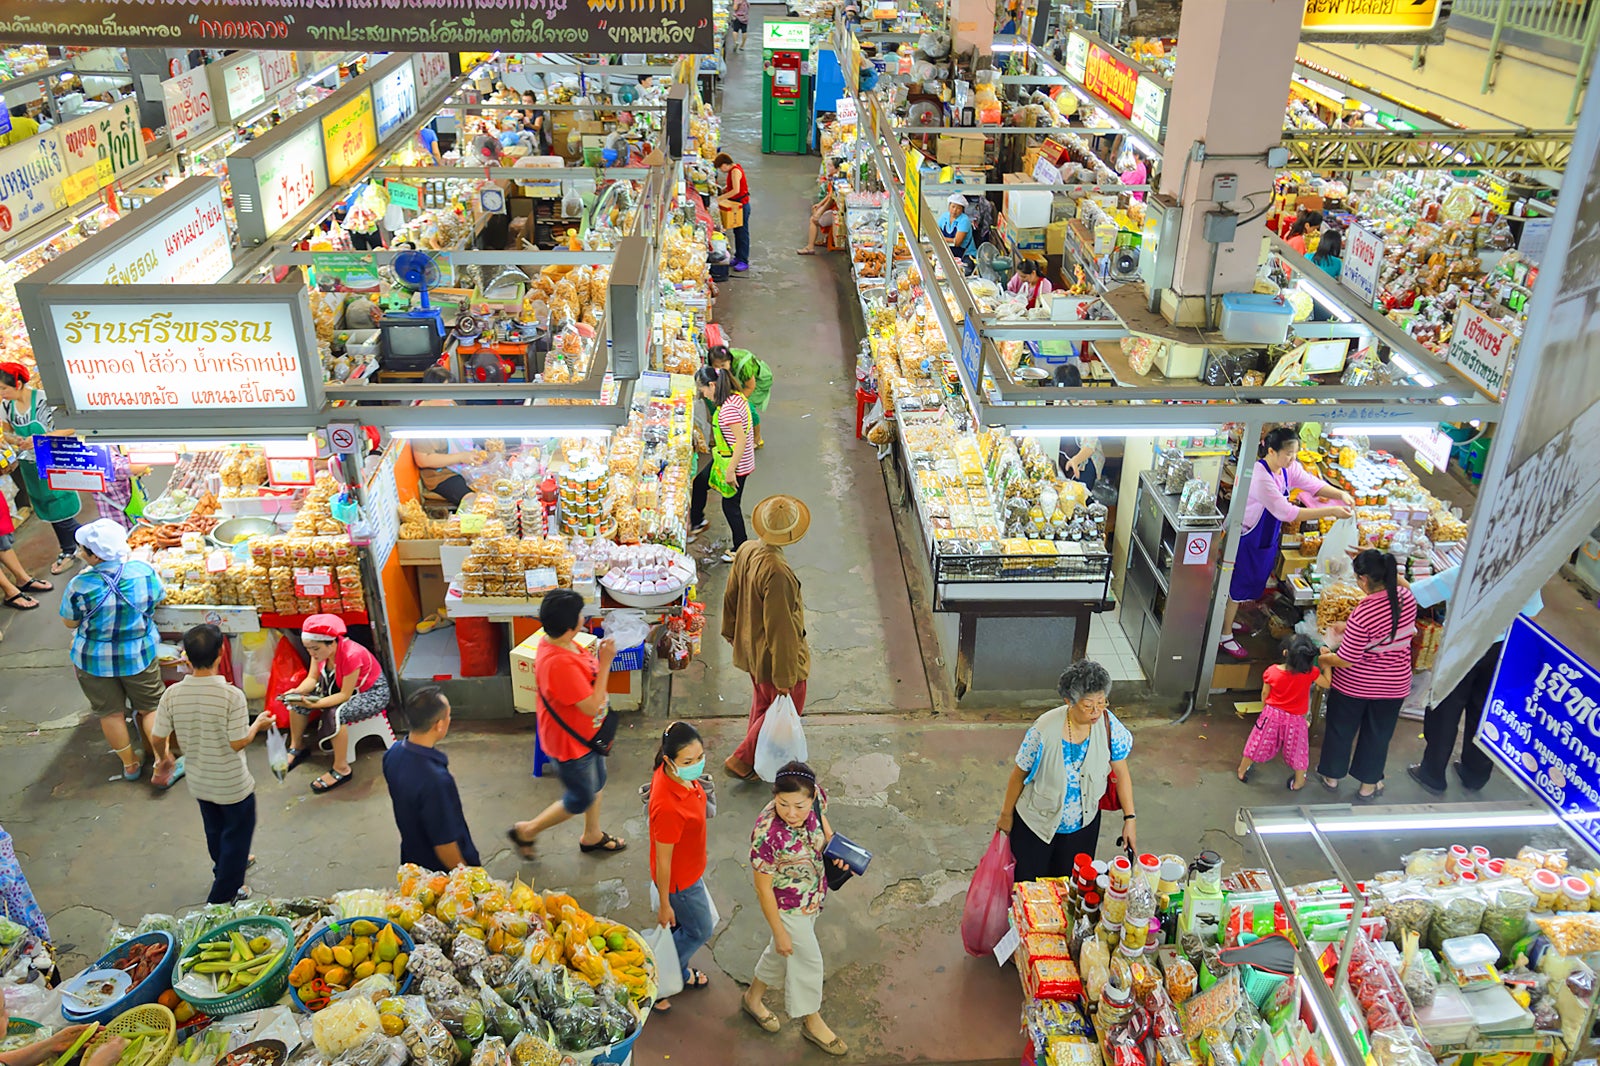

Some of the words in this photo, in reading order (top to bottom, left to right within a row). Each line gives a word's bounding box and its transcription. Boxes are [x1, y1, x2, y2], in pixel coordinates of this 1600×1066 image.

[64, 311, 272, 343] ร้านศรีพรรณ
[66, 357, 134, 380] หมูทอด
[135, 348, 187, 374] ไส้อั่ว
[193, 347, 297, 377] น้ำพริกหนุ่ม
[87, 385, 179, 406] แหนมหม้อ
[1536, 769, 1566, 806] (053)
